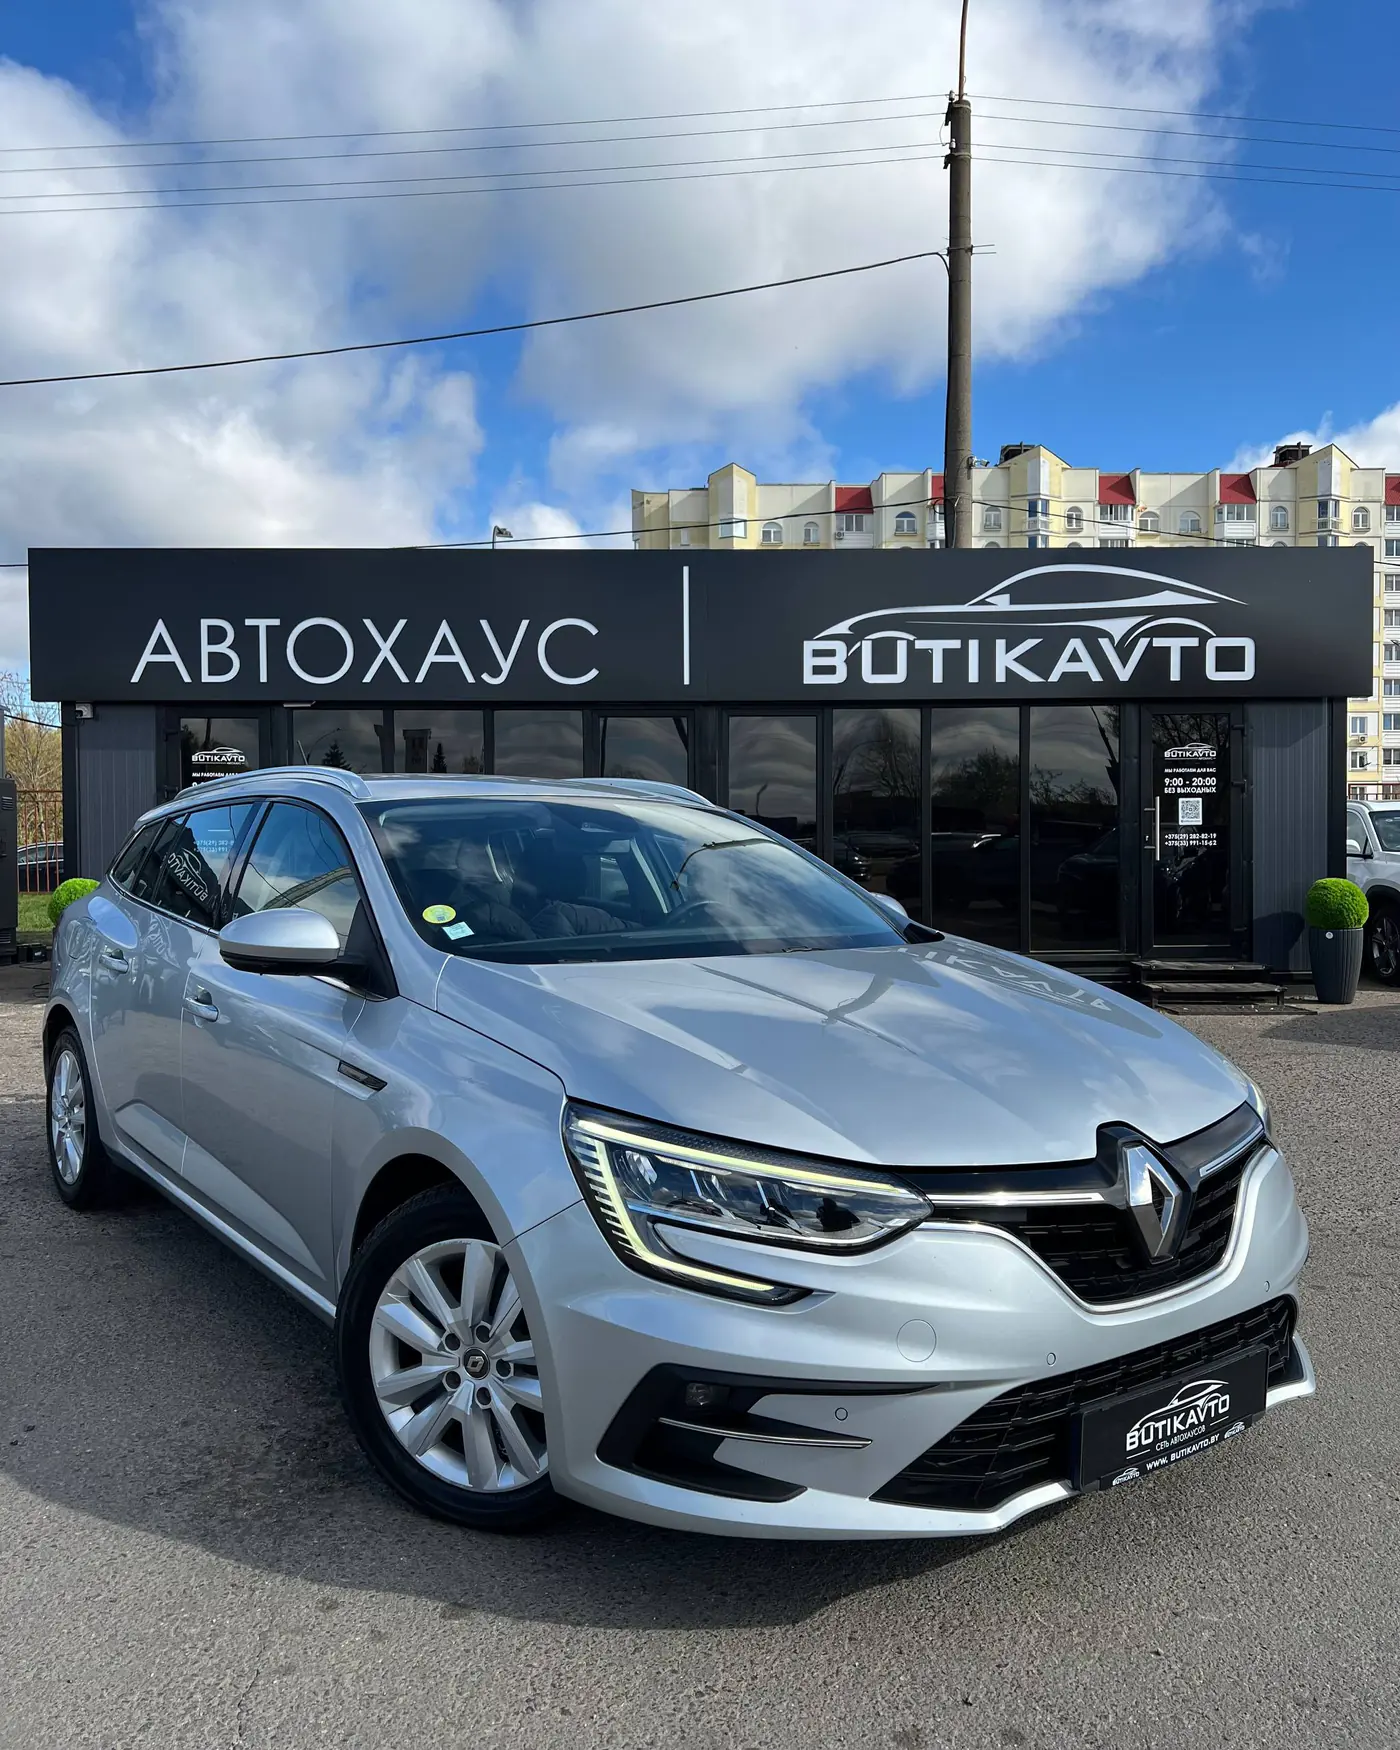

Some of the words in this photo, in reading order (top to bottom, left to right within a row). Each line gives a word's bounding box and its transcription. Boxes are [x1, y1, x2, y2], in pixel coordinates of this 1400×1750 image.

[130, 617, 600, 685] АВТОХАУС
[803, 636, 1256, 685] BUTIKAVTO
[1164, 777, 1183, 786] 9:00
[1192, 776, 1217, 786] 20:00
[1176, 786, 1217, 794] ВЫХОДНЫХ
[1125, 1394, 1230, 1451] BUTIKAVTO
[1155, 1440, 1170, 1451] СЕТЬ
[1170, 1424, 1206, 1446] АВТОХАУСОВ
[1146, 1456, 1169, 1471] WWW.
[1170, 1433, 1220, 1462] BUTIKAVTO.BY
